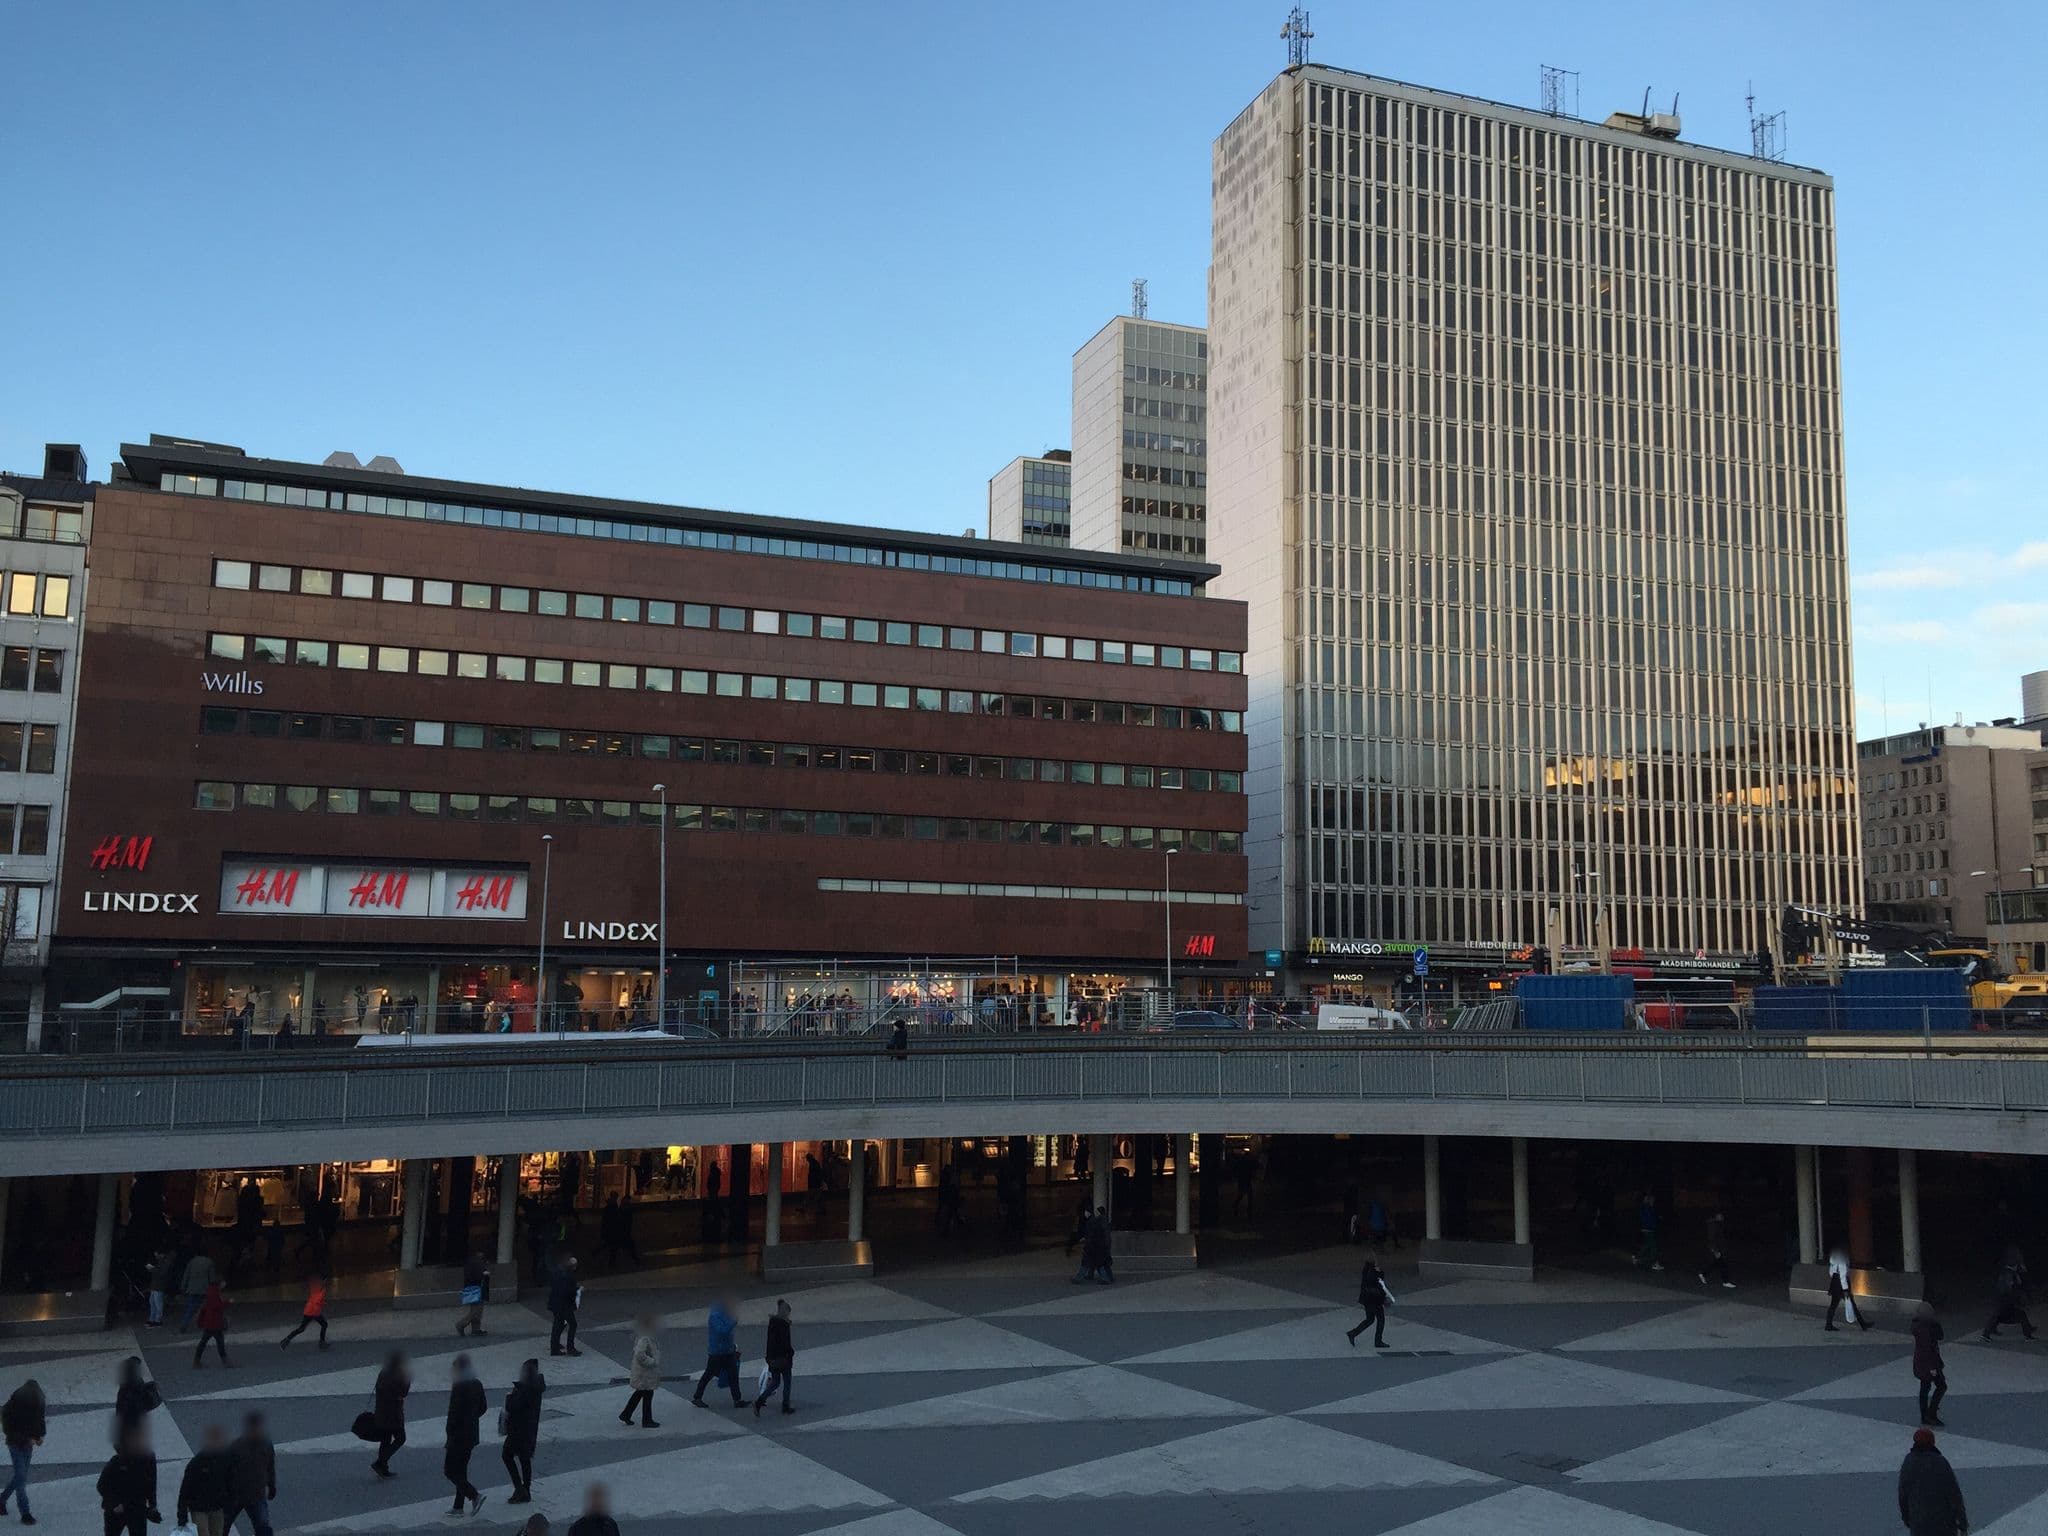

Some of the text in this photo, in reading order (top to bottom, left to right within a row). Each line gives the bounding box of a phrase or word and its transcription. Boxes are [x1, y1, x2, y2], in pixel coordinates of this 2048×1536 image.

[203, 670, 263, 694] Willis
[90, 835, 153, 871] H&M
[236, 867, 299, 906] H&M
[349, 871, 409, 909] H&M
[456, 875, 514, 912] H&M
[84, 891, 199, 913] LINDEX
[563, 921, 658, 941] LINDEX
[1836, 930, 1870, 941] OLVO
[1330, 943, 1382, 954] MANGO
[1384, 944, 1428, 952] avonoa
[1660, 960, 1740, 969] AKADEMIBOKHANDELN
